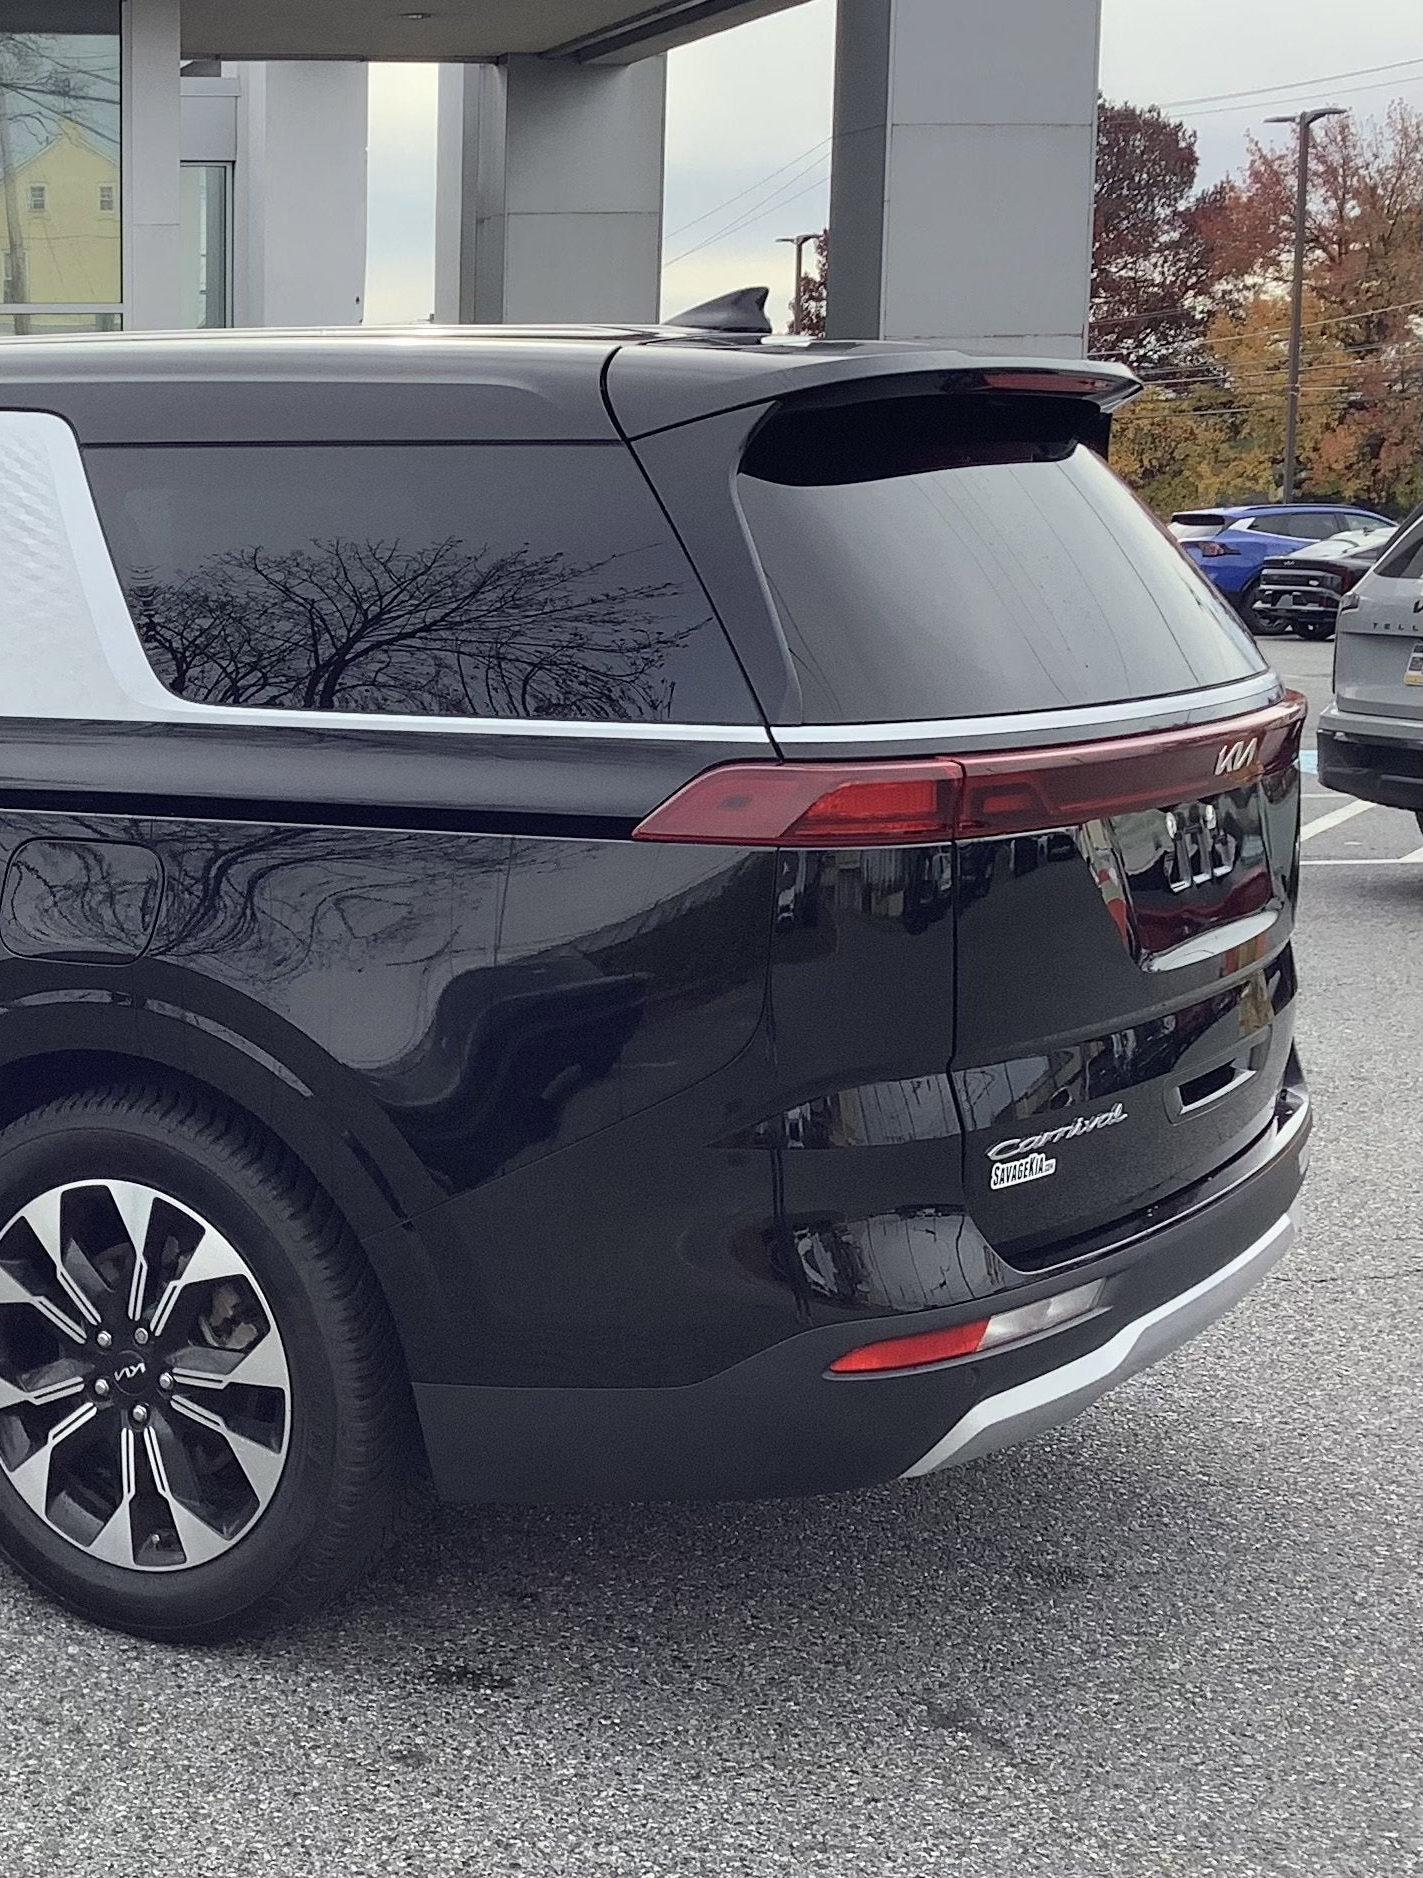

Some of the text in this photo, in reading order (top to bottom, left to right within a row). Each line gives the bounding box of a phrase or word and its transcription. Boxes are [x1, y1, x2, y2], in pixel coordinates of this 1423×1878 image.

[1373, 622, 1419, 632] TELL
[1214, 738, 1258, 775] KIA
[987, 1102, 1128, 1161] Carnival
